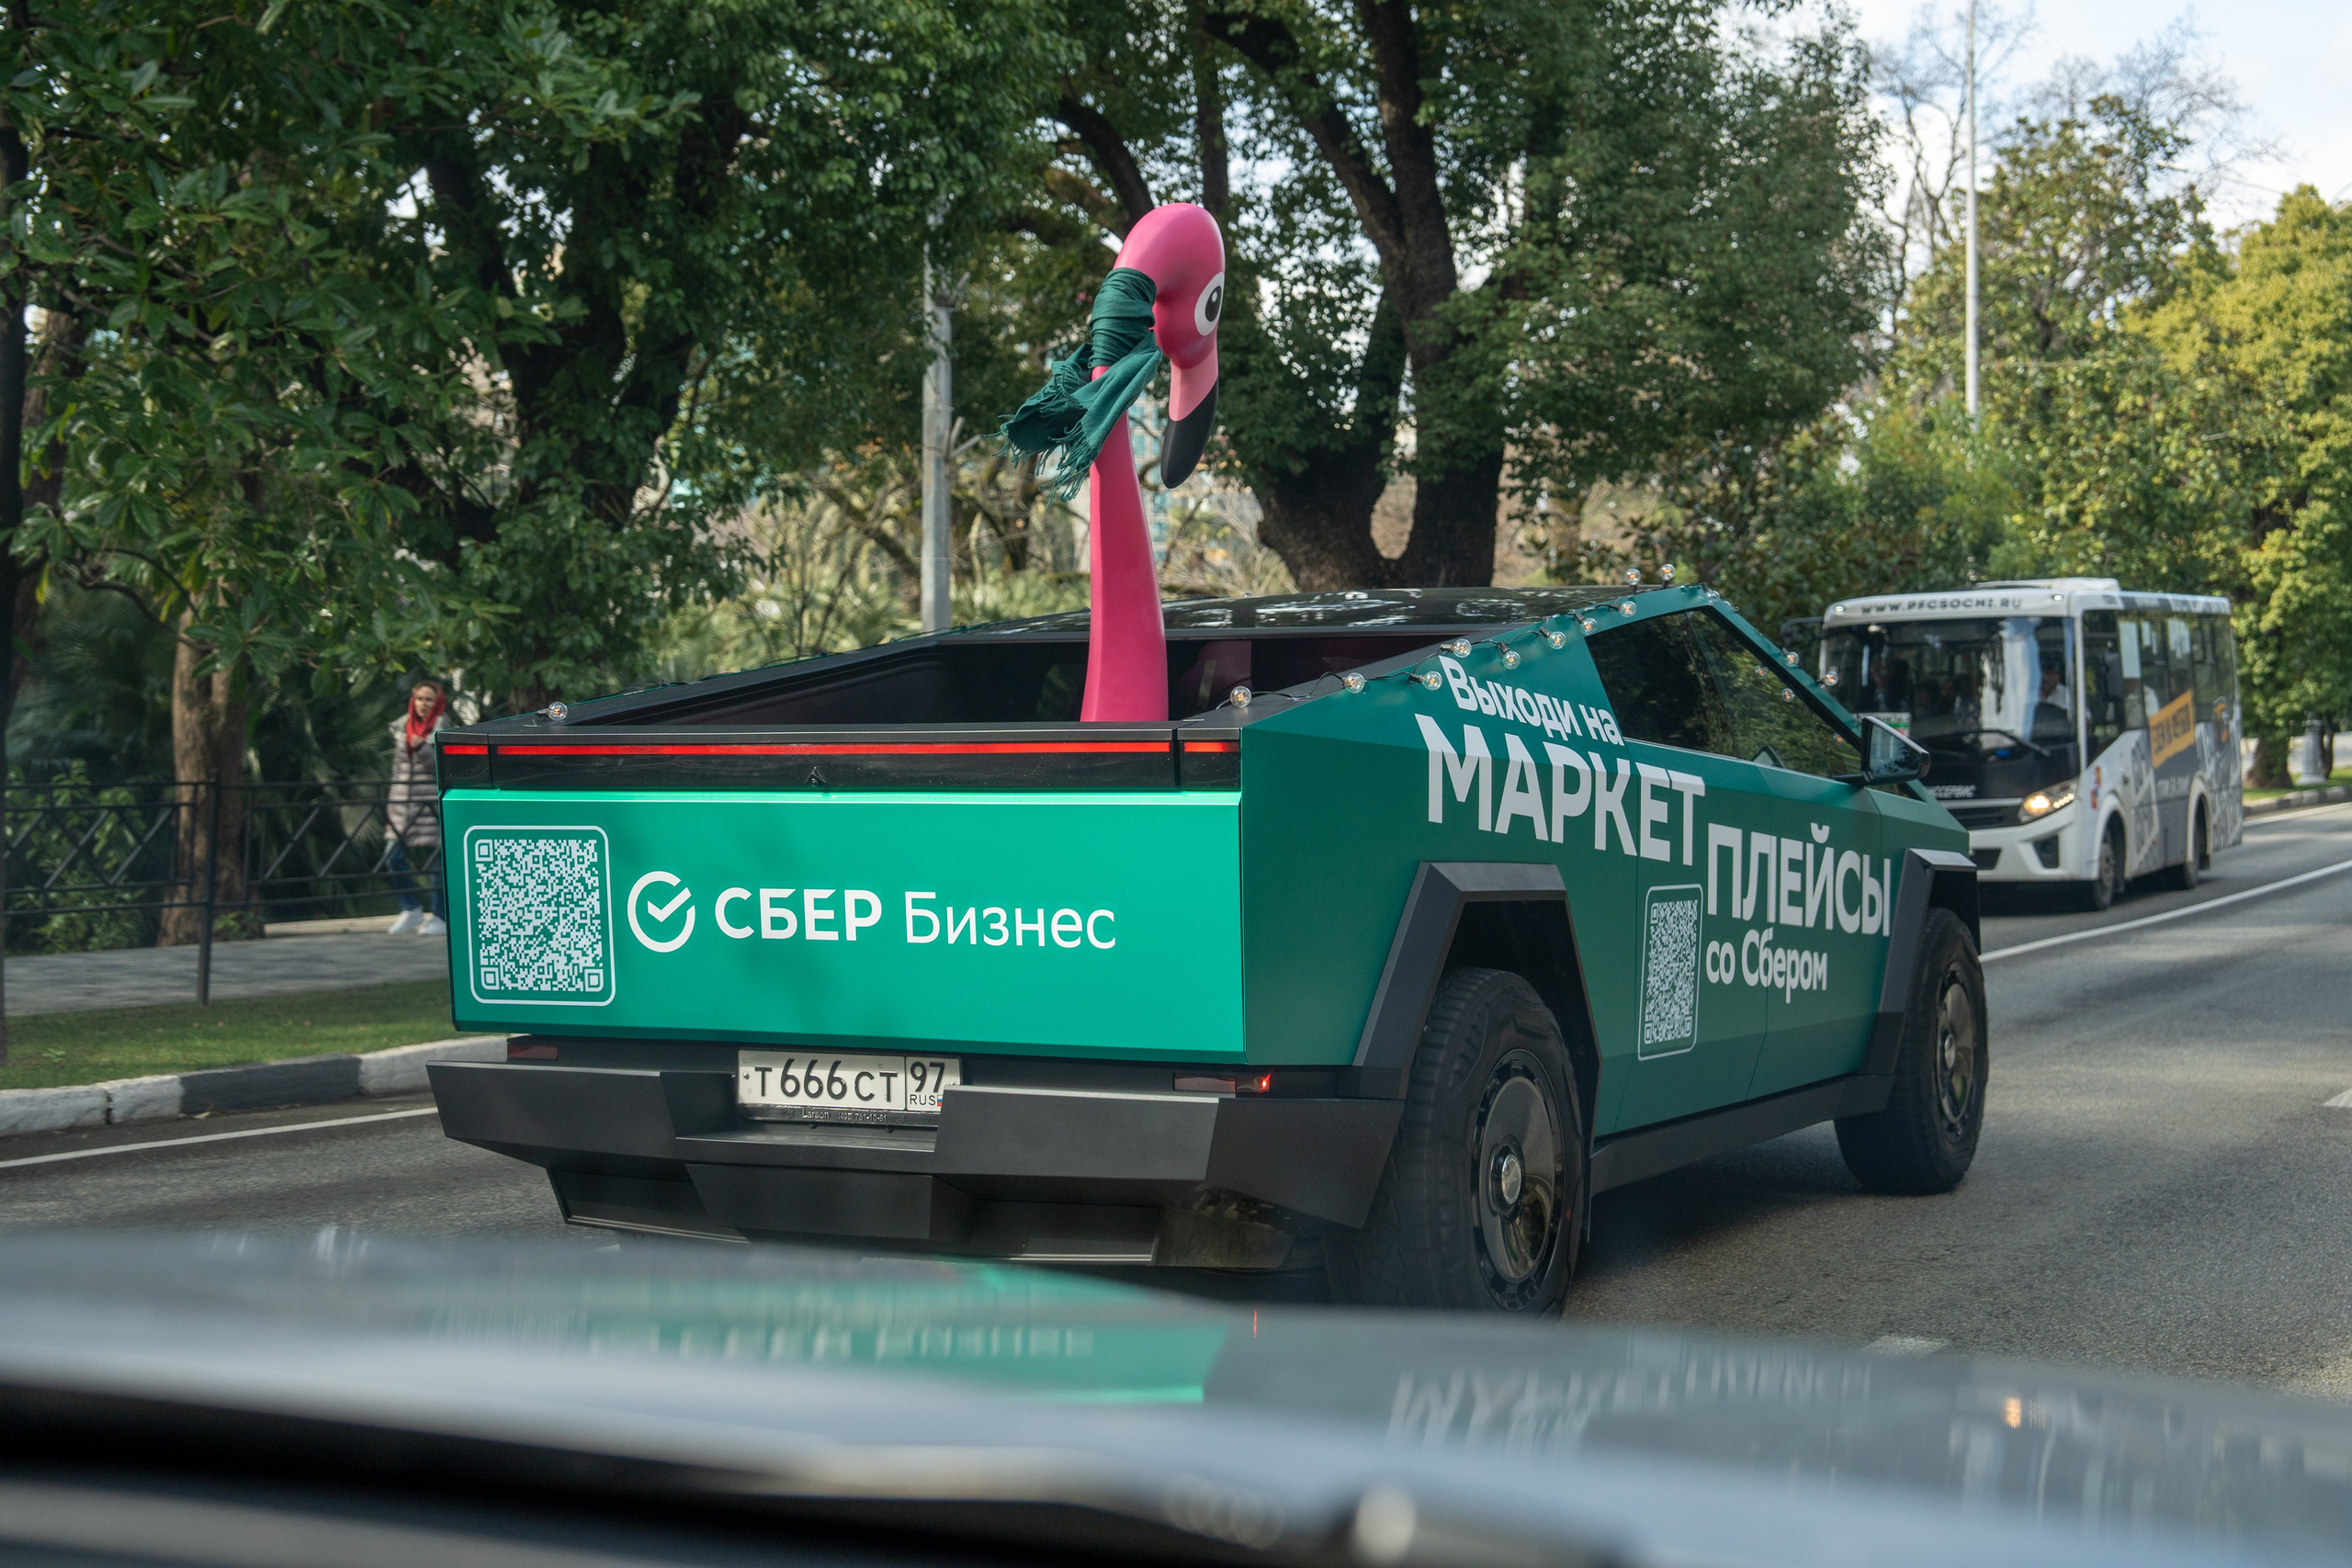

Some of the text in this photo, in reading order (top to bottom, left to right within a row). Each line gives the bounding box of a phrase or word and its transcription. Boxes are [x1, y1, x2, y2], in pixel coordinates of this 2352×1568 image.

[1439, 655, 1625, 747] Выходи на
[1414, 713, 1706, 866] МАРКЕТ
[1707, 822, 1892, 938] ПЛЕЙСЫ
[715, 887, 1116, 950] СБЕР Бизнес
[1705, 927, 1828, 1005] со Сбером
[910, 1062, 945, 1093] 97
[910, 1094, 936, 1106] RUS
[801, 1108, 830, 1120] Larson
